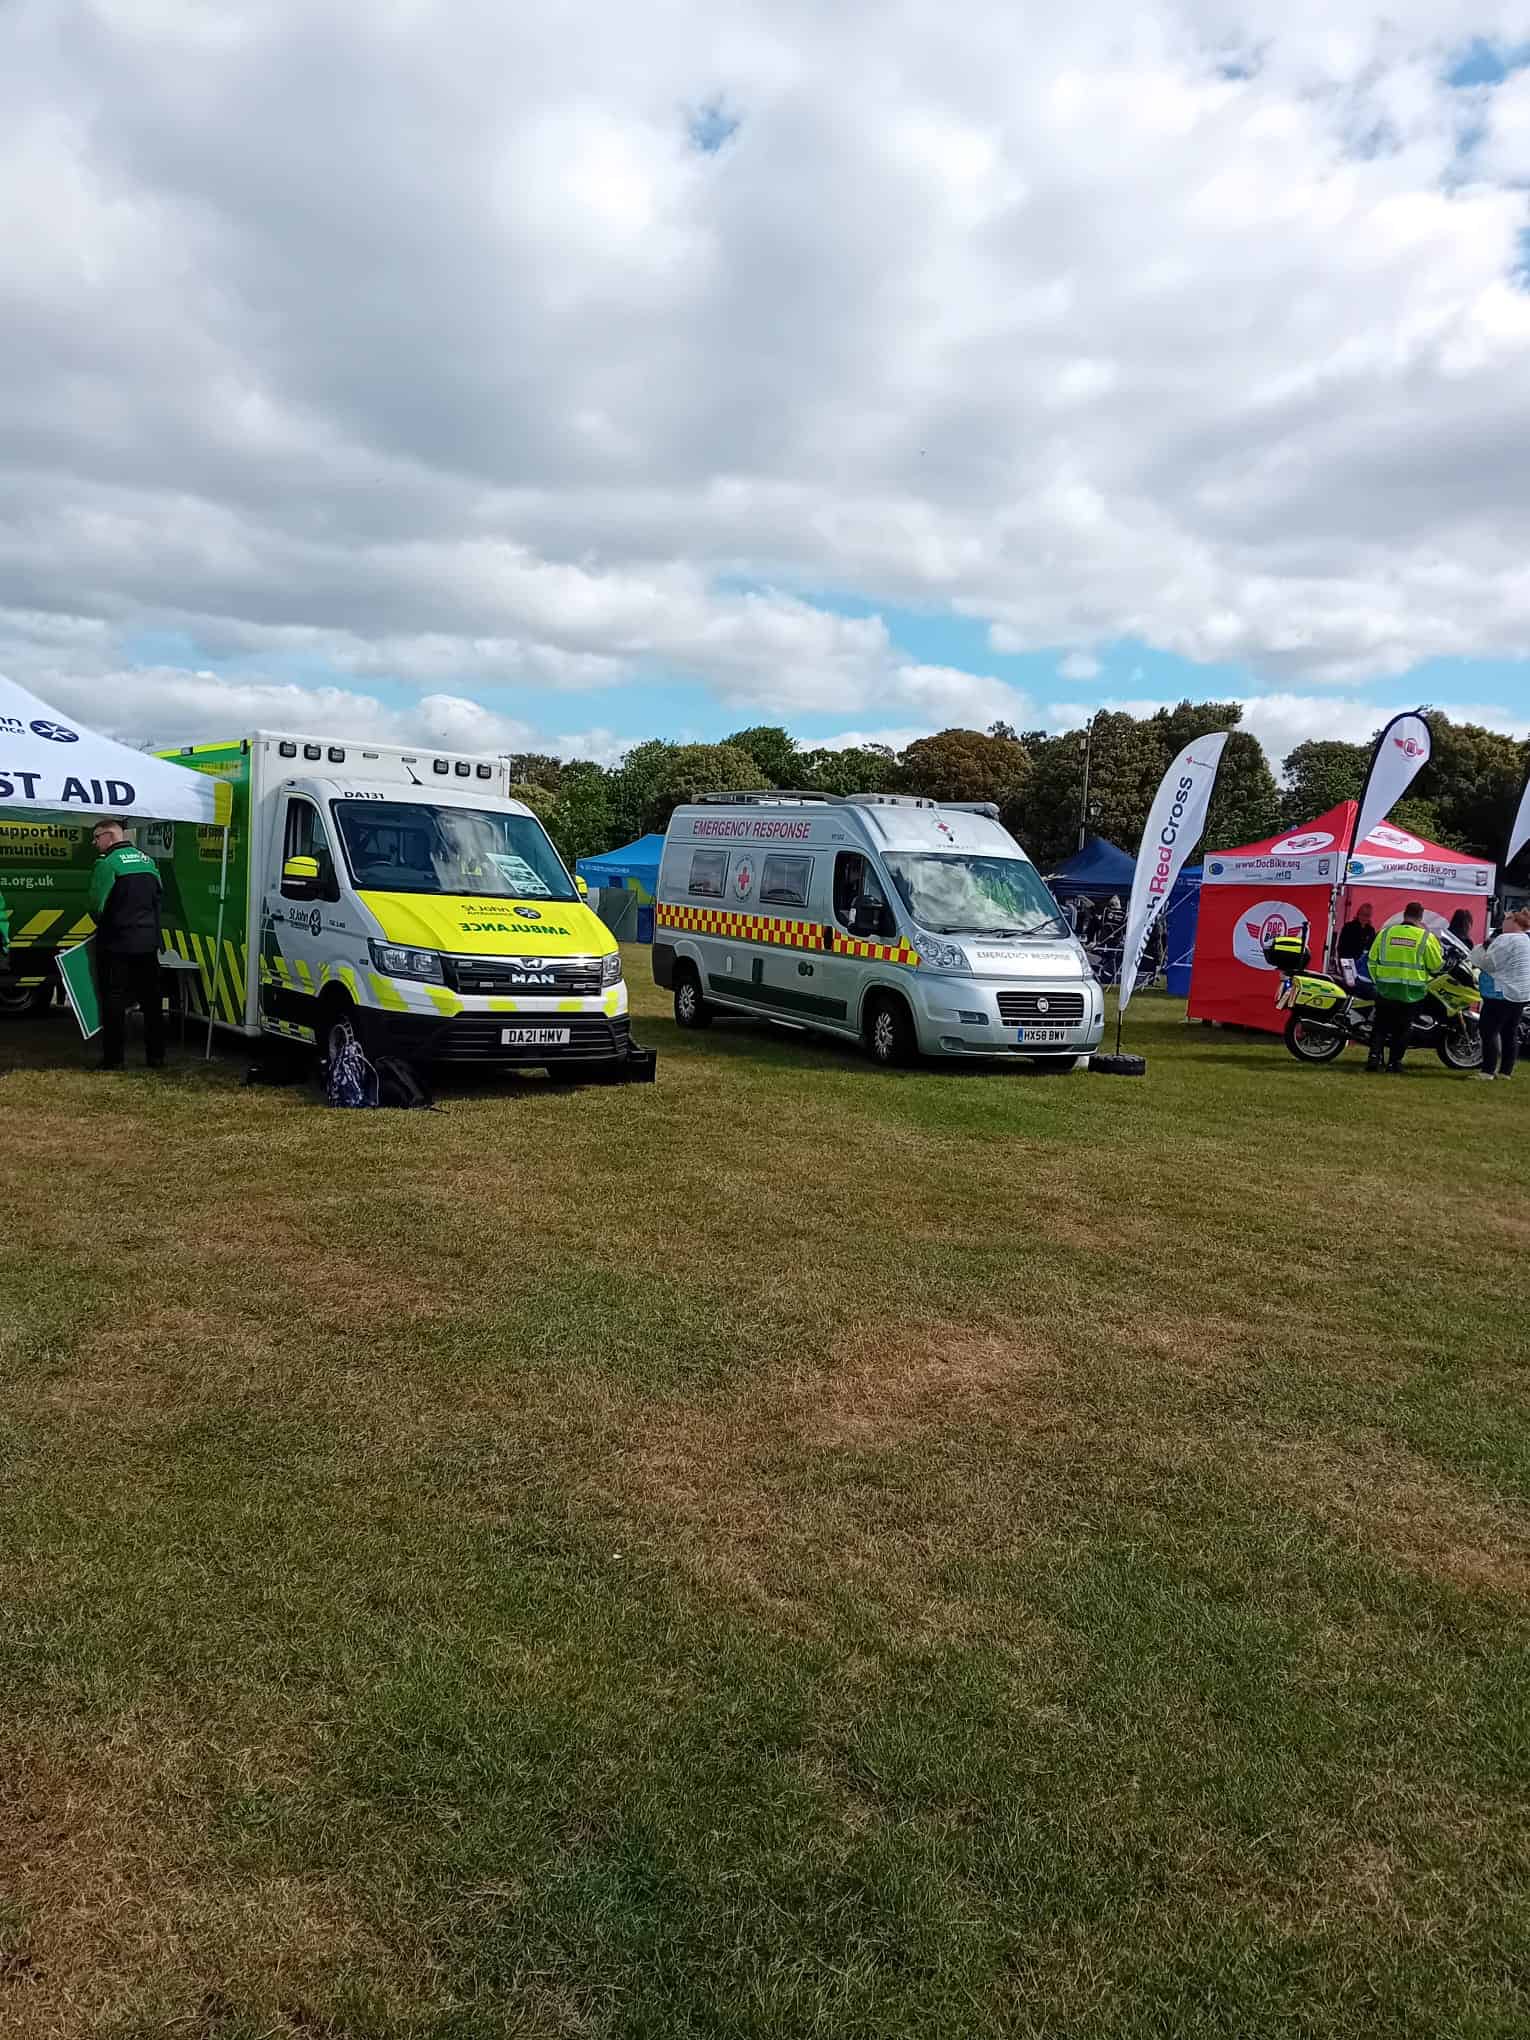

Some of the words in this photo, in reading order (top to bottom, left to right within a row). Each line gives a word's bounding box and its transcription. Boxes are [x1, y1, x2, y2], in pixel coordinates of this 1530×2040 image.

[61, 777, 136, 806] AID
[692, 820, 750, 836] EMERGENCY
[752, 821, 812, 839] RESPONSE
[0, 843, 67, 857] munities
[511, 973, 555, 984] MAN
[509, 1030, 536, 1042] DA21
[540, 1030, 563, 1042] HMV
[1024, 1030, 1047, 1041] HX58
